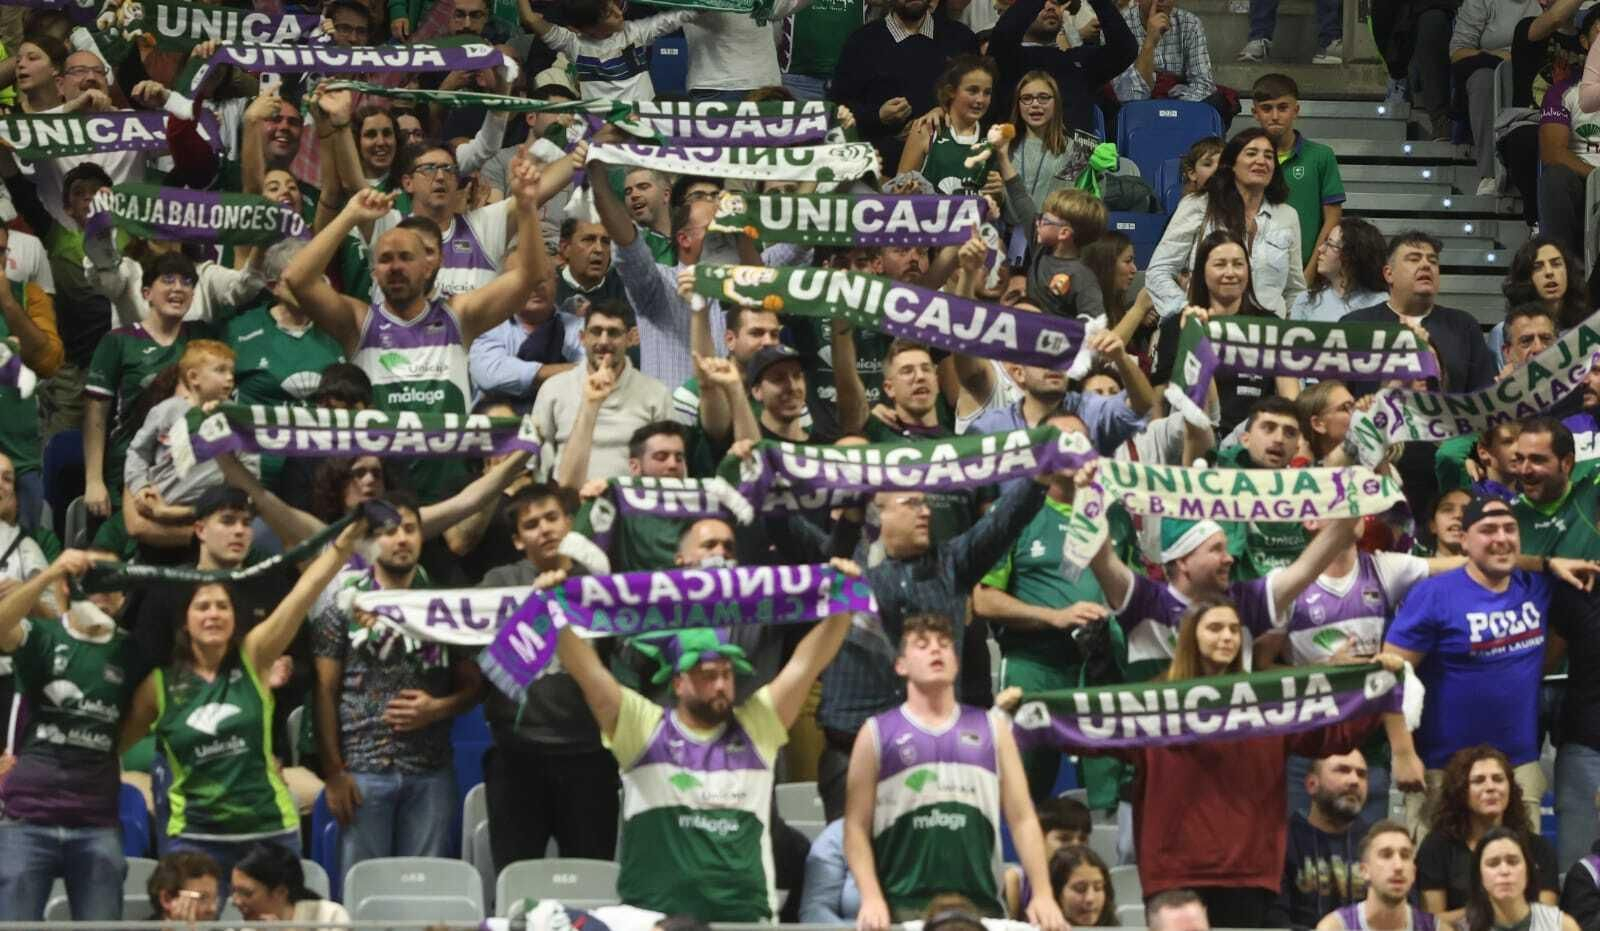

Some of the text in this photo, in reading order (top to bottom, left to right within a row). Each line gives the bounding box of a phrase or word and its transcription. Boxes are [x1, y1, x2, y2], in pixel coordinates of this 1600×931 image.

[221, 40, 446, 66] UNICAJA
[621, 100, 828, 138] NICAJA
[759, 195, 982, 233] UNICAJA
[788, 269, 1019, 350] UNICAJA
[1413, 323, 1600, 416] UNICAJA
[250, 404, 494, 452] UNICAJA
[780, 430, 1037, 487] UNICAJA
[1110, 462, 1320, 496] UNICAJA
[1466, 601, 1541, 643] POLO
[1073, 672, 1341, 739] UNICAJA
